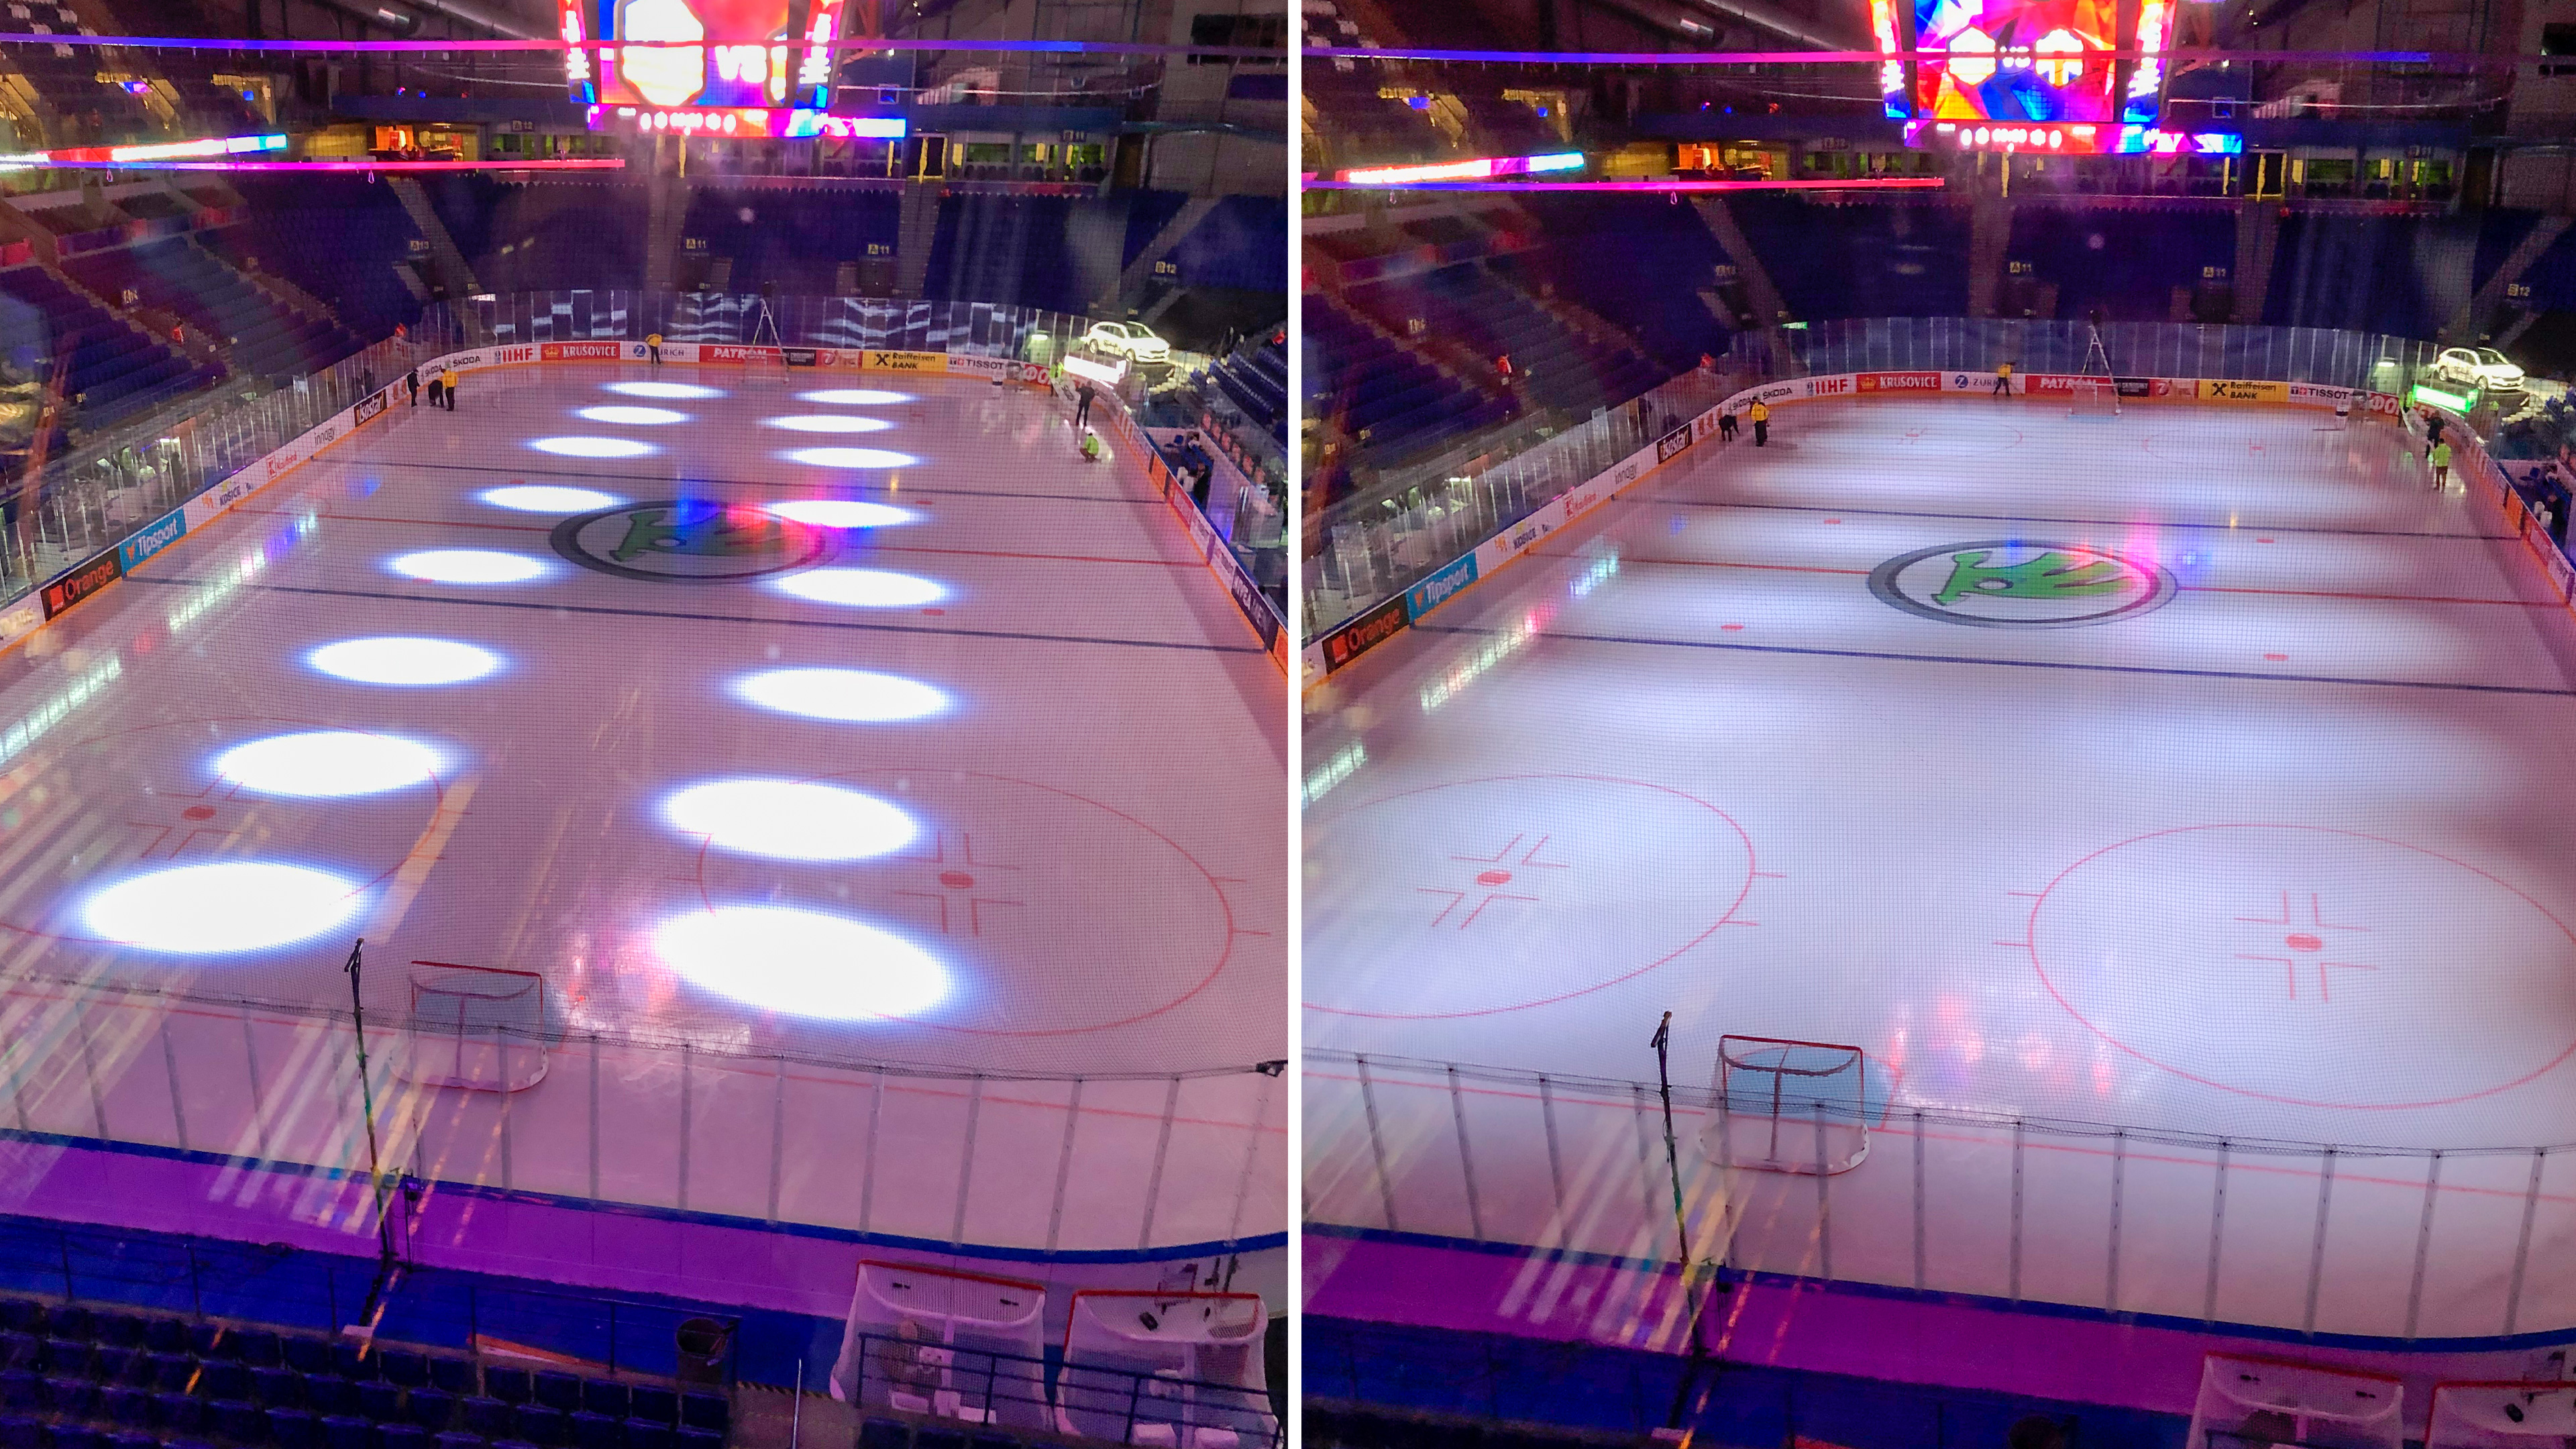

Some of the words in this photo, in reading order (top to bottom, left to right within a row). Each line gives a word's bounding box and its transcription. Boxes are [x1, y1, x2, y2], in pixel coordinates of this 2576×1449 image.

[502, 347, 533, 362] IIHF
[892, 352, 936, 362] Raiffeisen
[892, 362, 918, 370] BANK
[966, 359, 1005, 370] TISSOT
[1815, 378, 1848, 394] IIHF
[2230, 381, 2277, 392] Raiffeisen
[2308, 388, 2349, 399] TISSOT
[138, 517, 178, 557] Tipsport
[65, 561, 114, 600] Orange
[1348, 608, 1400, 651] Orange
